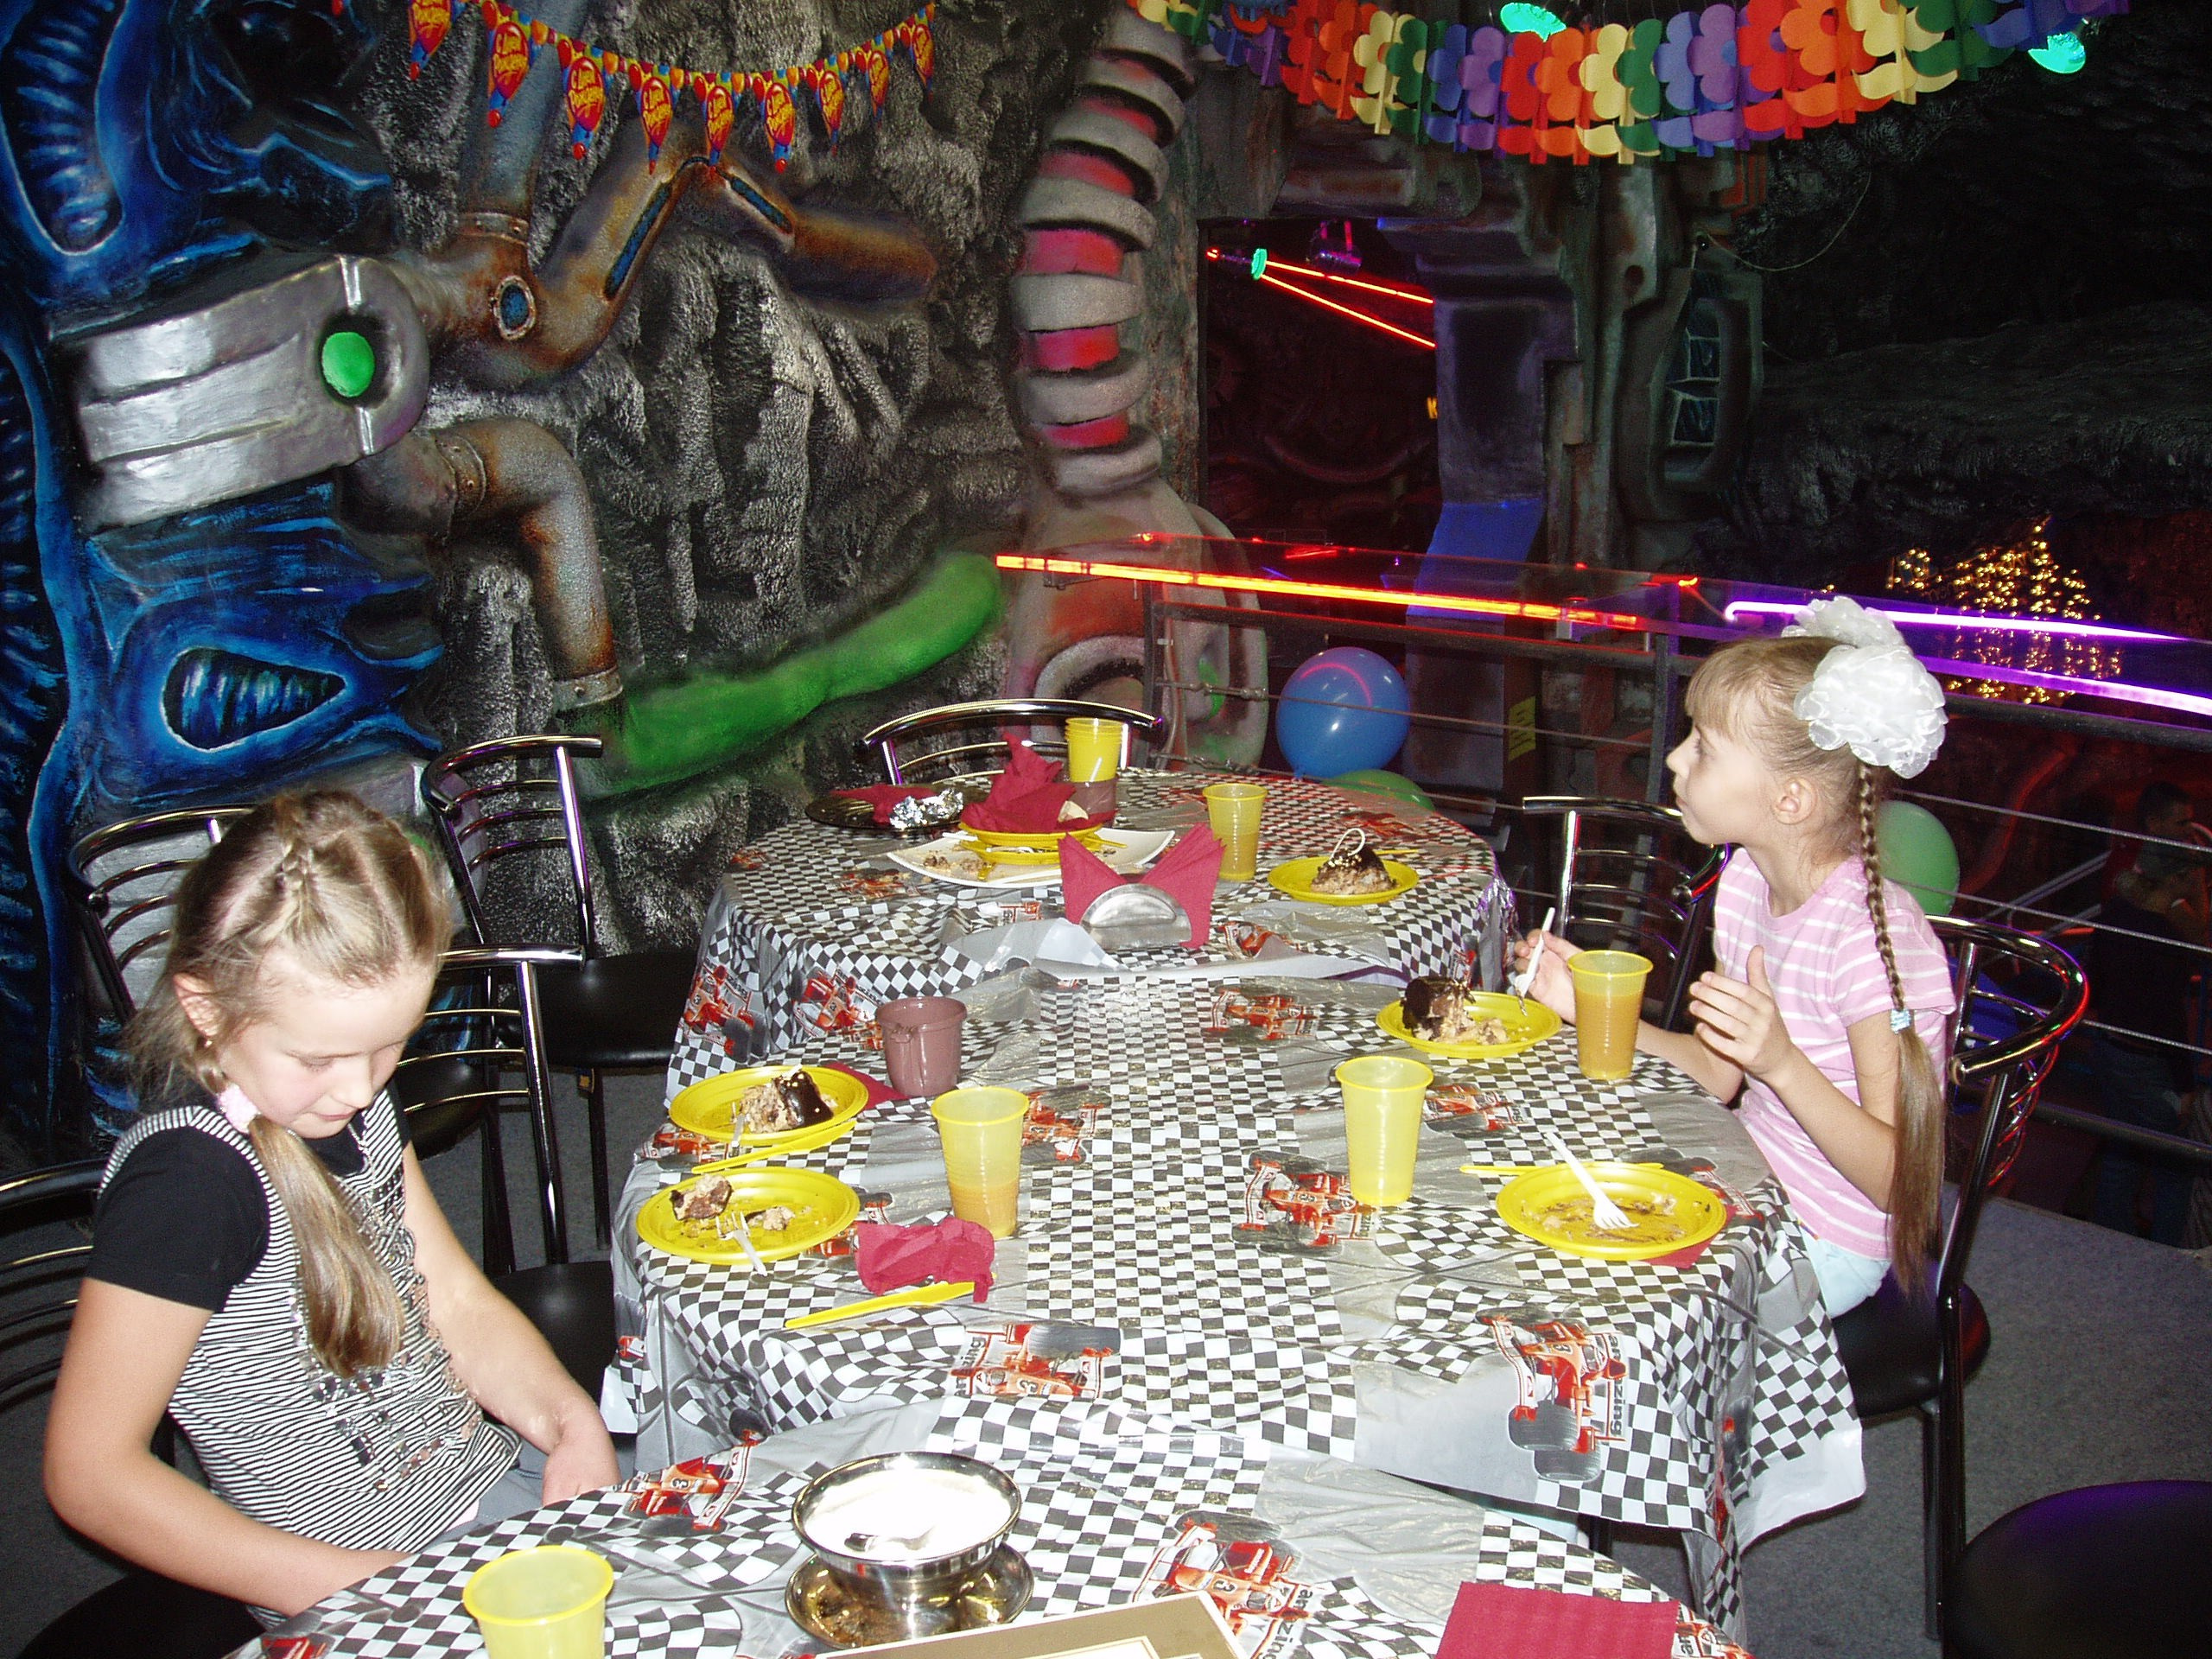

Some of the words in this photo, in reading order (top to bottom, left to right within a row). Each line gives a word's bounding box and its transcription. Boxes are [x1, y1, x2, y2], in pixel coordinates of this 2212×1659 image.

[1553, 1344, 1572, 1353] 3
[954, 1337, 987, 1399] amzing
[1608, 1334, 1626, 1435] amzing
[671, 1478, 690, 1489] 3
[1212, 1580, 1236, 1592] 3
